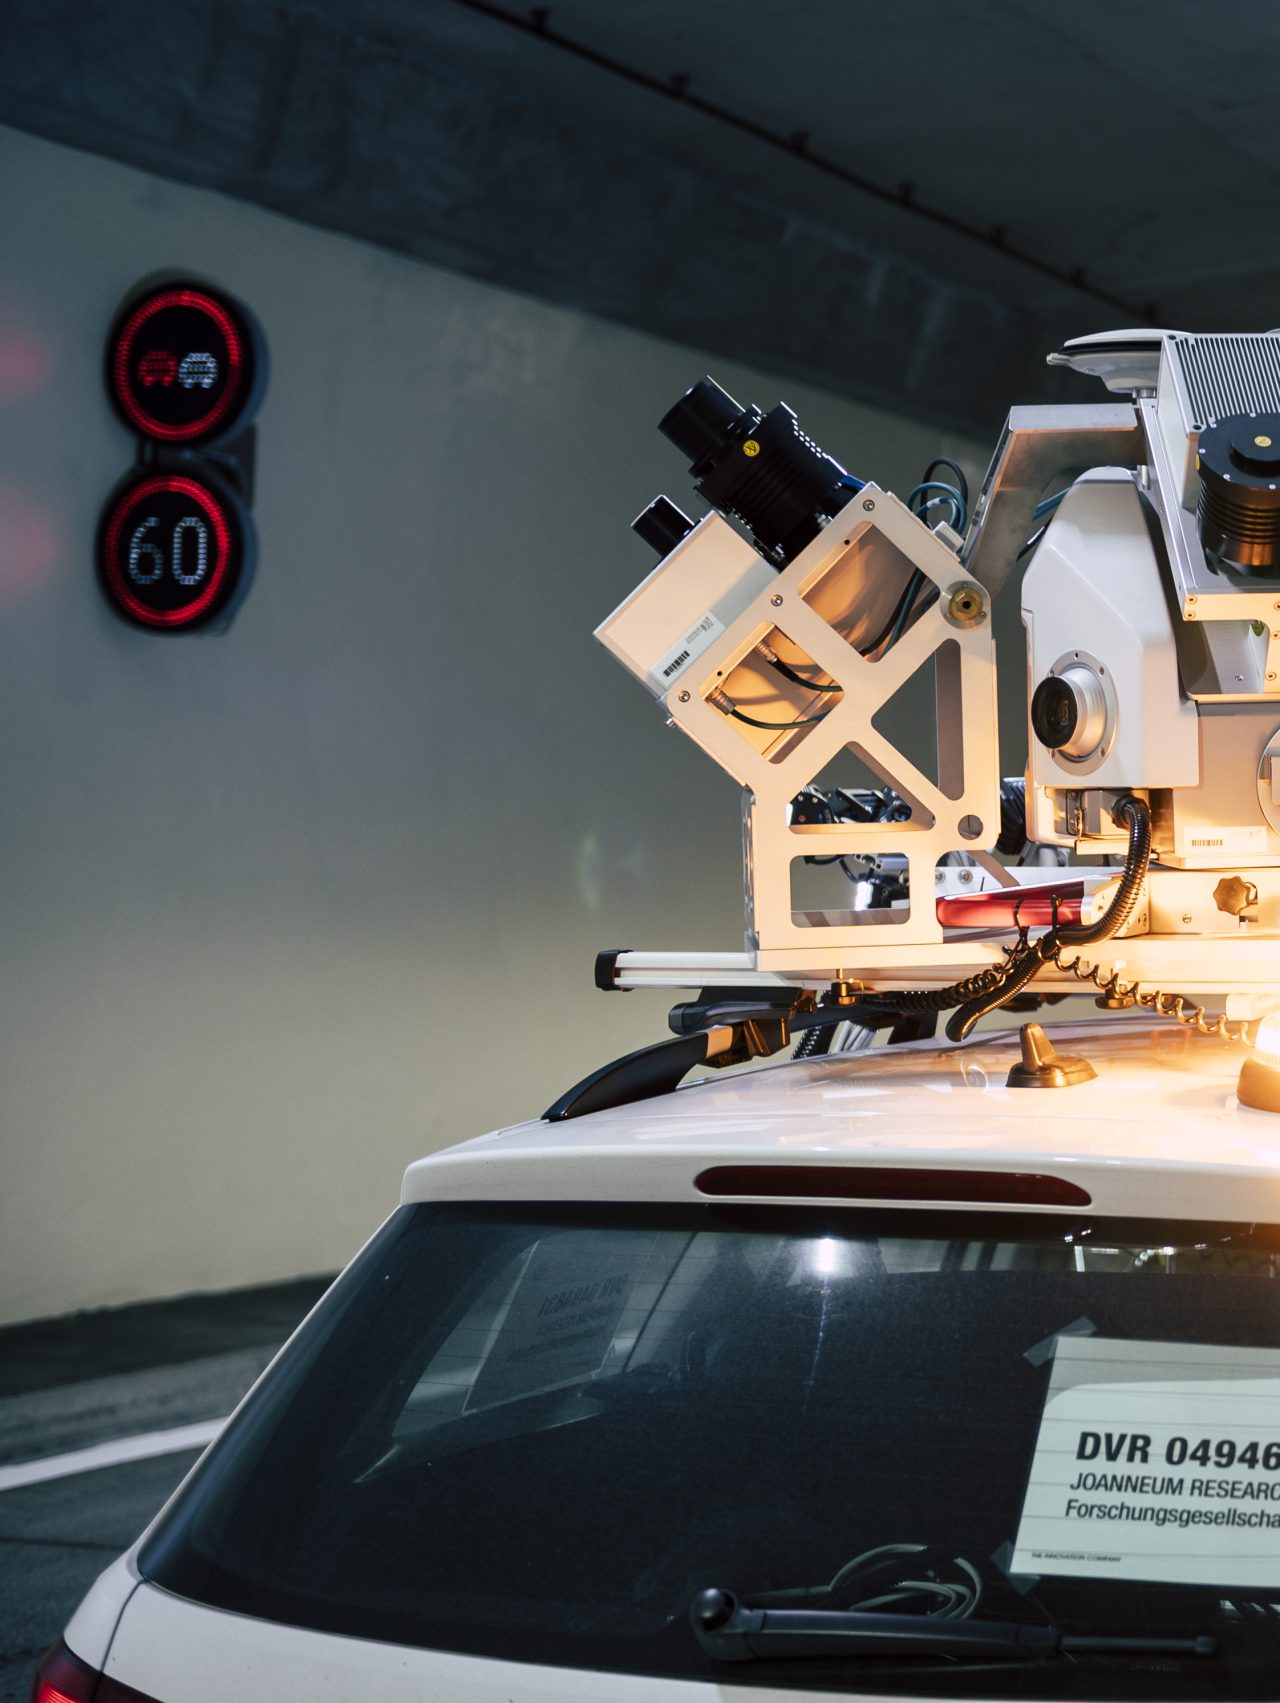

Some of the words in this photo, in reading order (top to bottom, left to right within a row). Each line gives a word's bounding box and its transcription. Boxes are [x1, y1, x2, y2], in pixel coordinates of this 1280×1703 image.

[128, 517, 208, 585] 60
[1076, 1431, 1152, 1464] DVR
[1070, 1473, 1184, 1497] JOANNEUM
